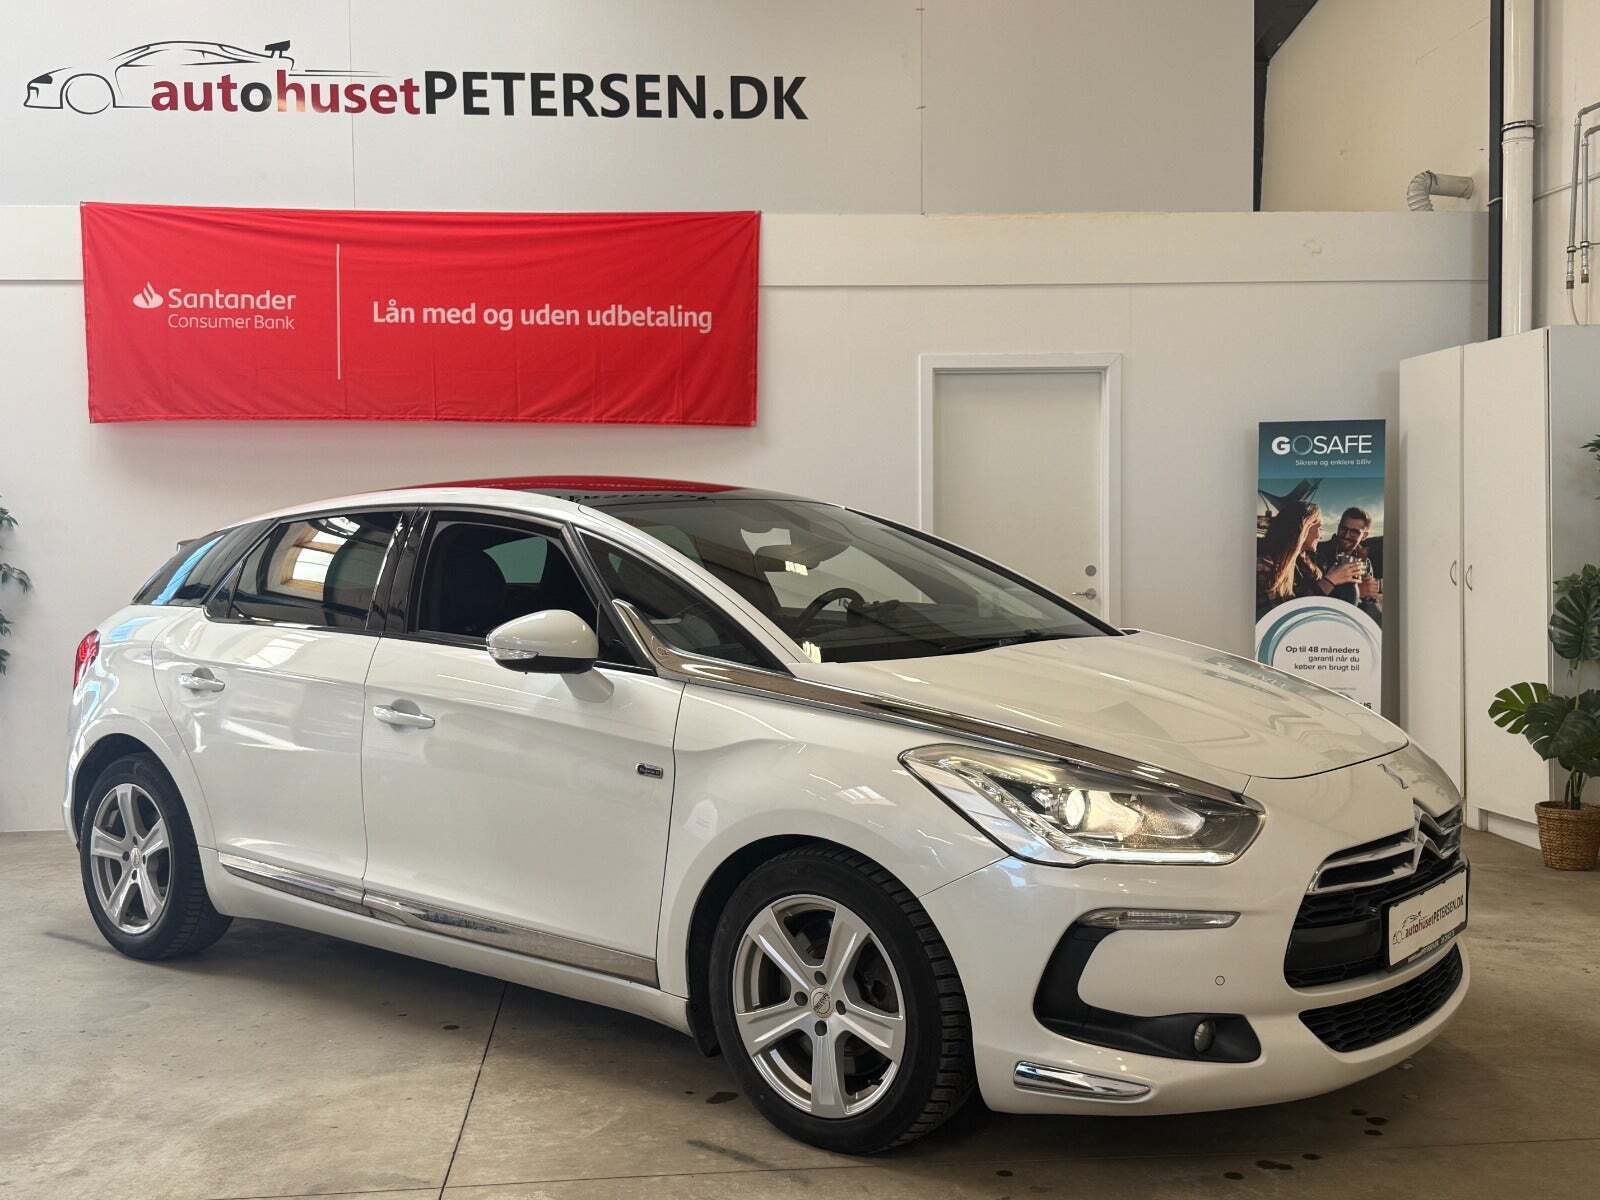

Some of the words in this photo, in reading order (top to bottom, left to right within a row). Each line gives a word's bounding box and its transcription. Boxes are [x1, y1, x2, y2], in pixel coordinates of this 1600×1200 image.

[151, 70, 809, 120] autohusetPETERSEN.DK
[168, 287, 297, 310] Santander
[168, 313, 251, 329] Consumer
[254, 314, 296, 330] Bank
[372, 299, 416, 324] Lån
[423, 302, 476, 325] med
[483, 307, 513, 331] og
[520, 304, 580, 326] uden
[587, 304, 713, 334] udbetaling
[1271, 434, 1373, 455] GOSAFE
[1319, 460, 1329, 468] og
[1285, 645, 1298, 654] Op
[1299, 645, 1307, 653] til
[1308, 645, 1319, 653] 48
[1320, 645, 1360, 654] måneders
[1308, 655, 1334, 663] garanti
[1335, 654, 1348, 662] når
[1349, 655, 1360, 663] du
[1329, 663, 1349, 672] brugt
[1350, 663, 1360, 671] bil
